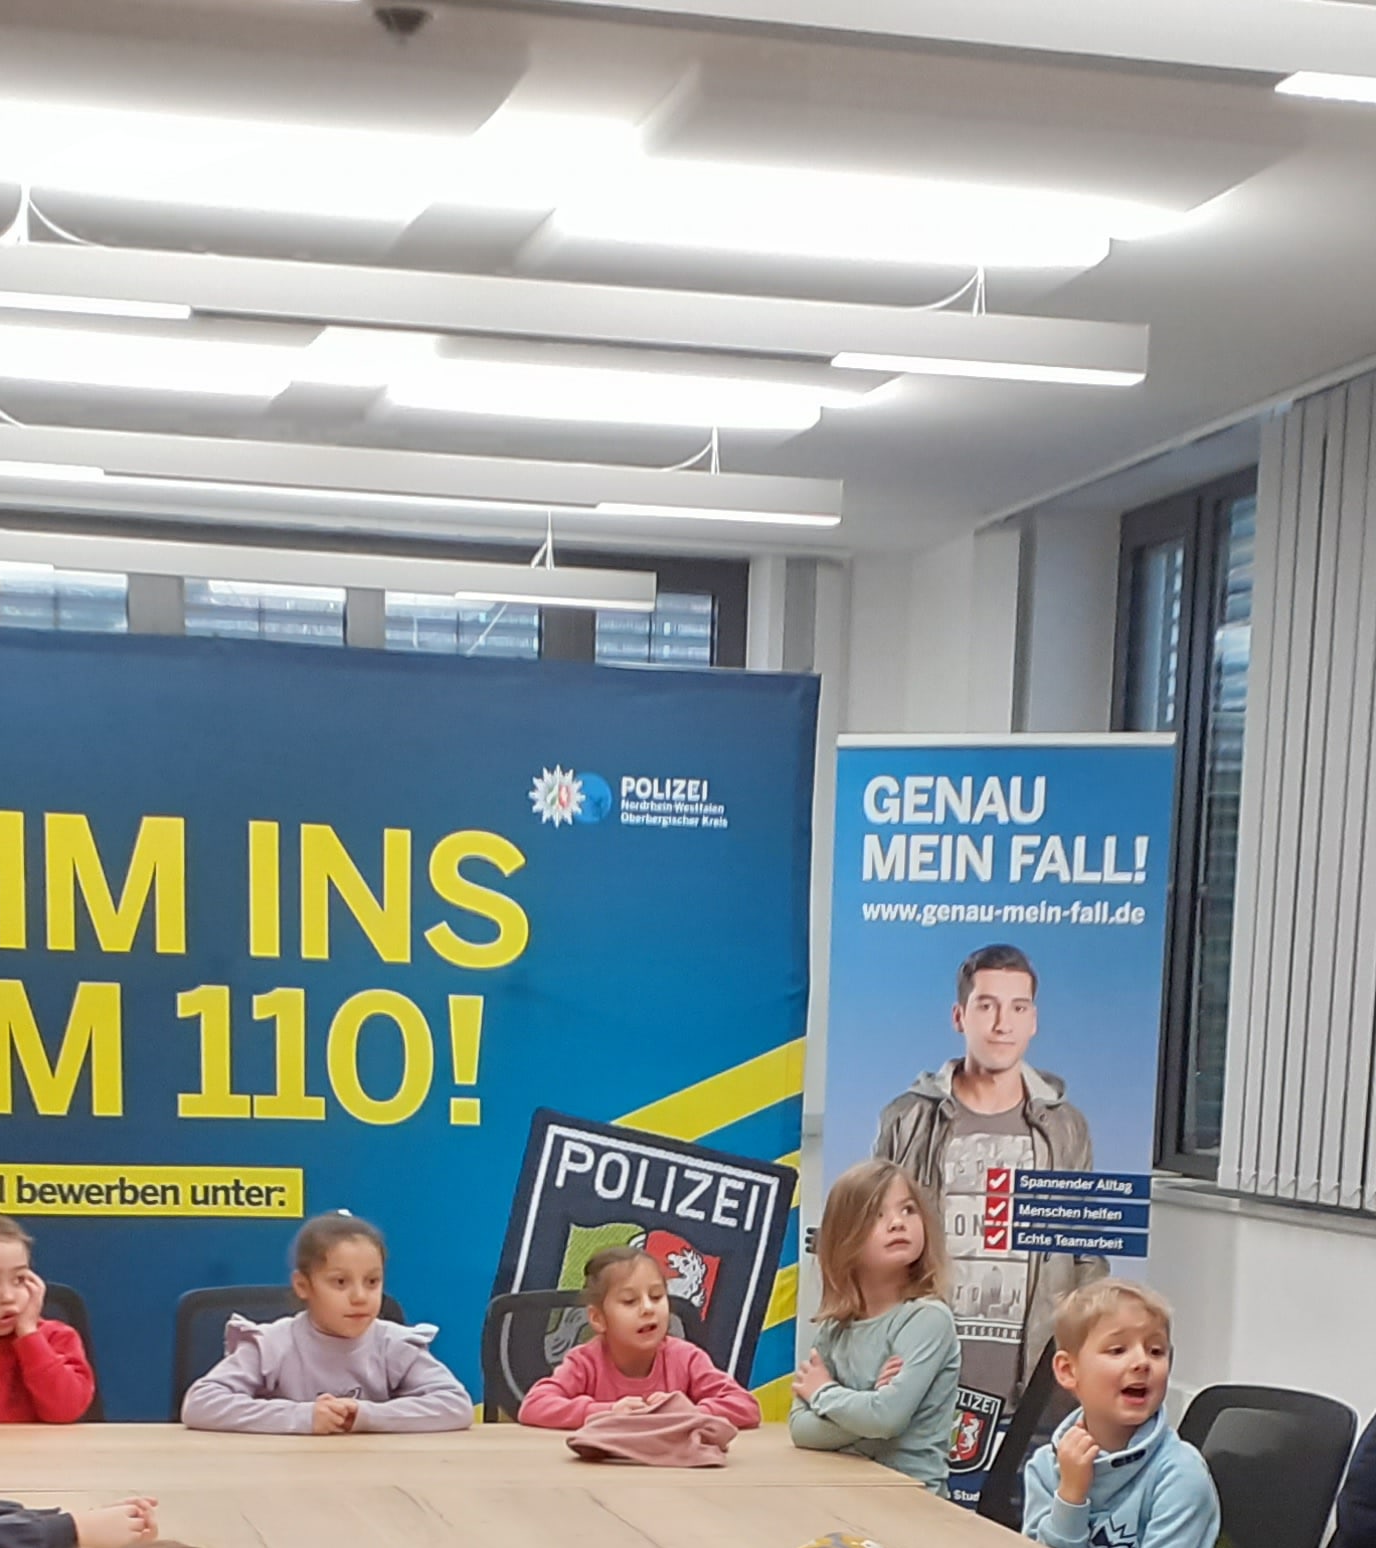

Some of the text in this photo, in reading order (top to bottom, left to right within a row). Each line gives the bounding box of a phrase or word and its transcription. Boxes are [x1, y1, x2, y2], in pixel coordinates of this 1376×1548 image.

[621, 776, 707, 801] POLIZEI
[863, 775, 1046, 824] GENAU
[621, 812, 728, 829] Oberbergischer Kreis
[862, 834, 1150, 884] MEIN FALL!
[248, 819, 529, 970] INS
[862, 900, 1146, 926] www.genau-mein-fall.de
[176, 984, 485, 1126] 110!
[16, 1171, 180, 1207] bewerben
[190, 1180, 287, 1207] unter:
[554, 1139, 760, 1232] POLIZEI
[1019, 1175, 1134, 1195] Spannender Alltag
[1018, 1204, 1123, 1221] Menschen helfen
[1017, 1232, 1124, 1250] Echte Teamarbeit
[957, 1391, 997, 1415] LIZEI
[953, 1489, 981, 1502] Stud
